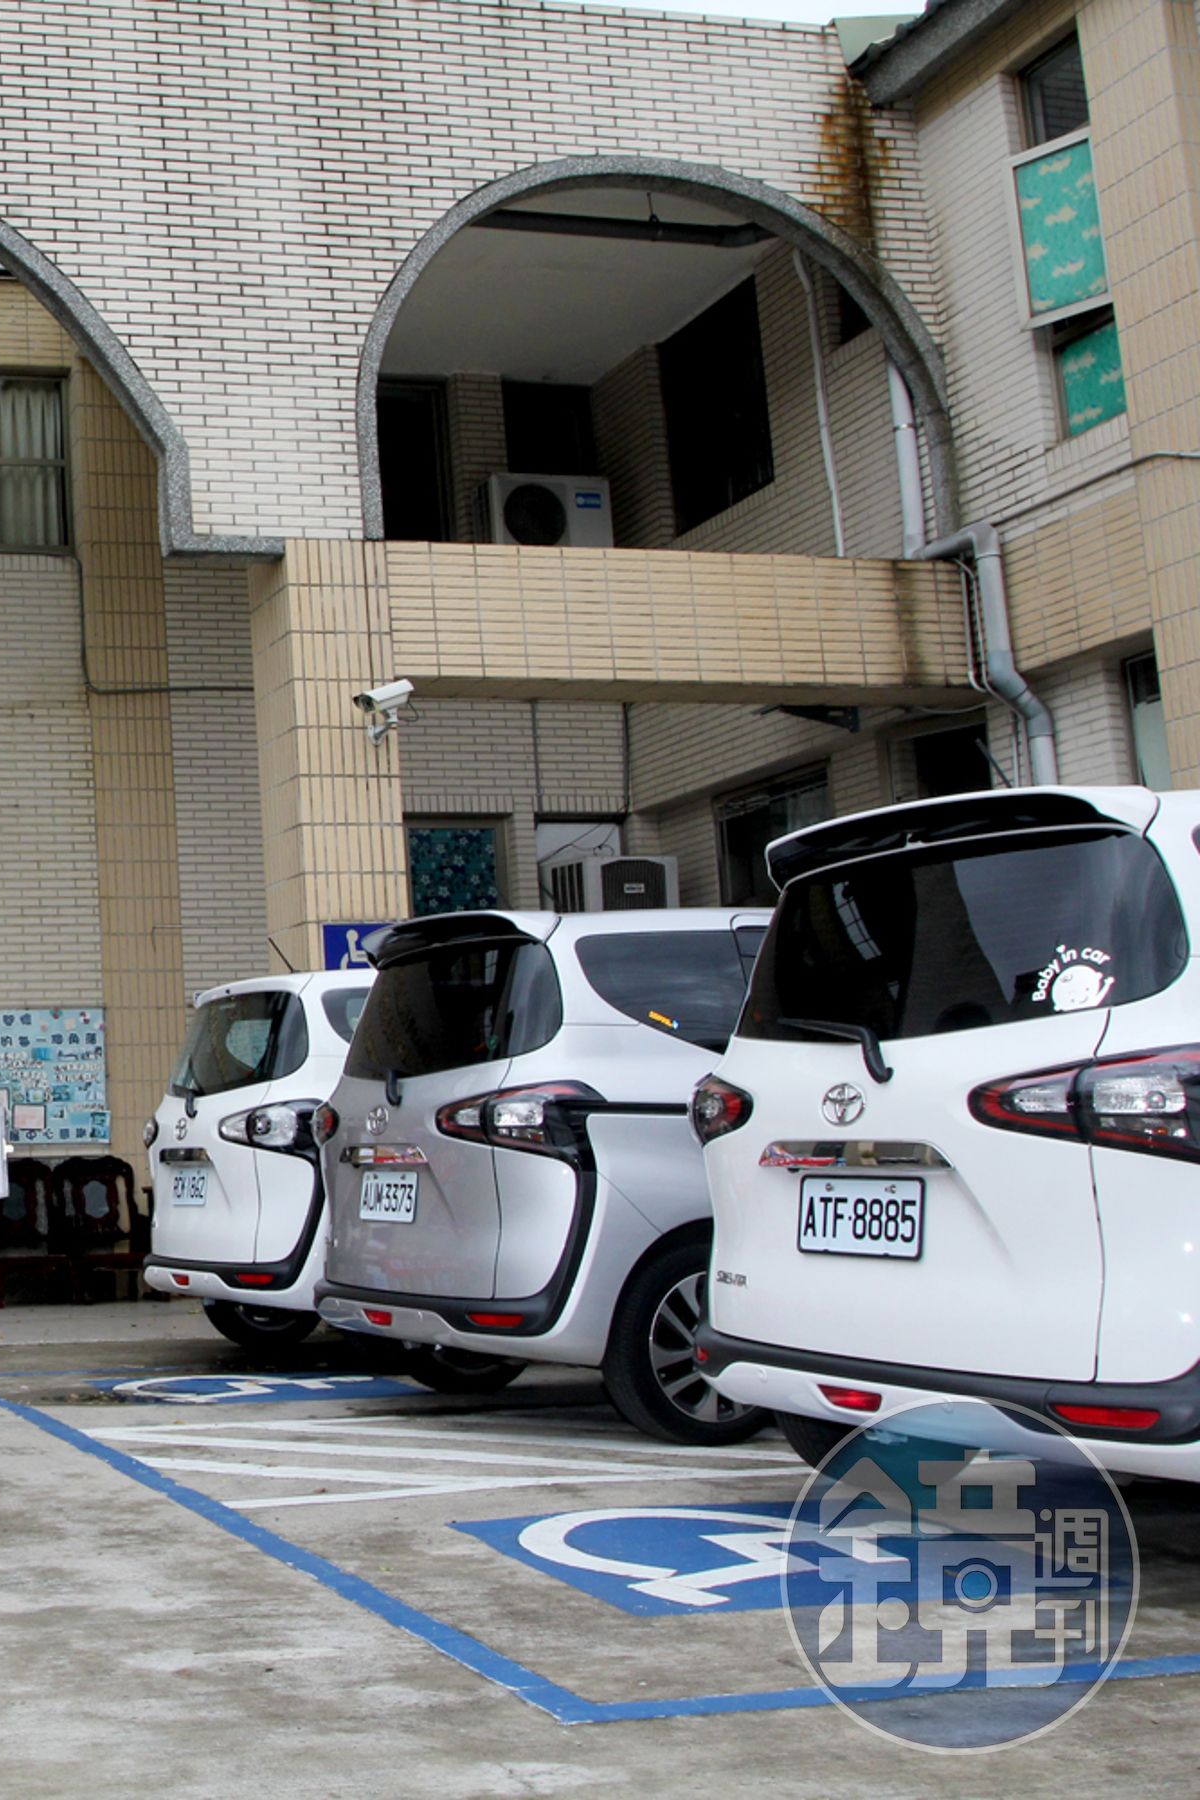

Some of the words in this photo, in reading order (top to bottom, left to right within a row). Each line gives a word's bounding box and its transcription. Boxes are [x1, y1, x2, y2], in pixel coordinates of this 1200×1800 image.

[1031, 958, 1061, 1002] Baby
[1056, 944, 1078, 963] in
[1081, 947, 1111, 965] car
